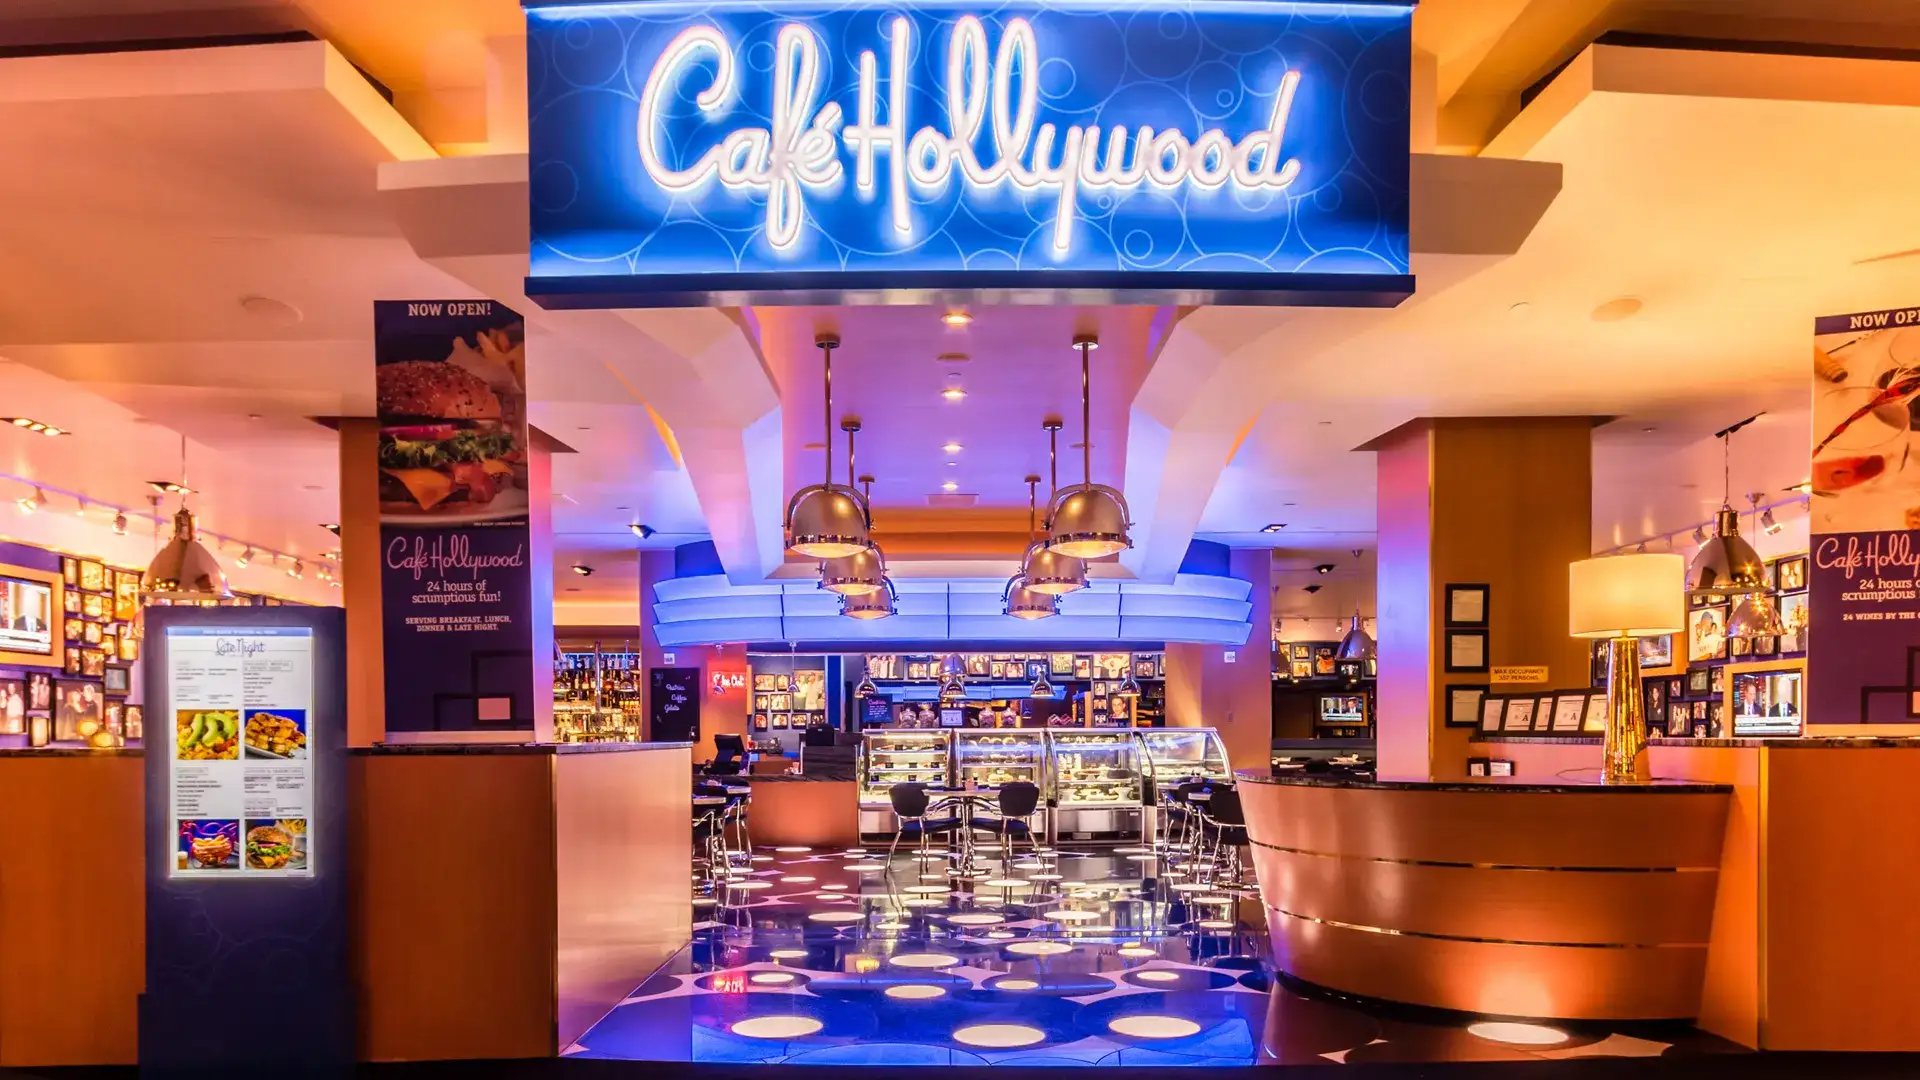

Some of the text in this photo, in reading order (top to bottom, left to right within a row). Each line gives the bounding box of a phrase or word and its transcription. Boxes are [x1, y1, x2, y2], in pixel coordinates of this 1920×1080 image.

[637, 15, 1301, 251] Café Hollywood
[408, 302, 491, 316] NOW OPEN!
[1850, 312, 1889, 329] NOW
[387, 534, 523, 580] Café Hollywood
[1816, 536, 1863, 579] Café
[427, 579, 487, 592] 24 hours of
[1859, 579, 1874, 590] 24
[1878, 578, 1912, 589] hours
[412, 591, 501, 605] scrumptious fun!
[1842, 589, 1915, 602] scrumptious
[405, 617, 437, 625] SERVING
[1855, 612, 1883, 620] WINES
[1885, 612, 1897, 620] BY
[416, 625, 445, 633] DINNER
[454, 624, 472, 632] LATE
